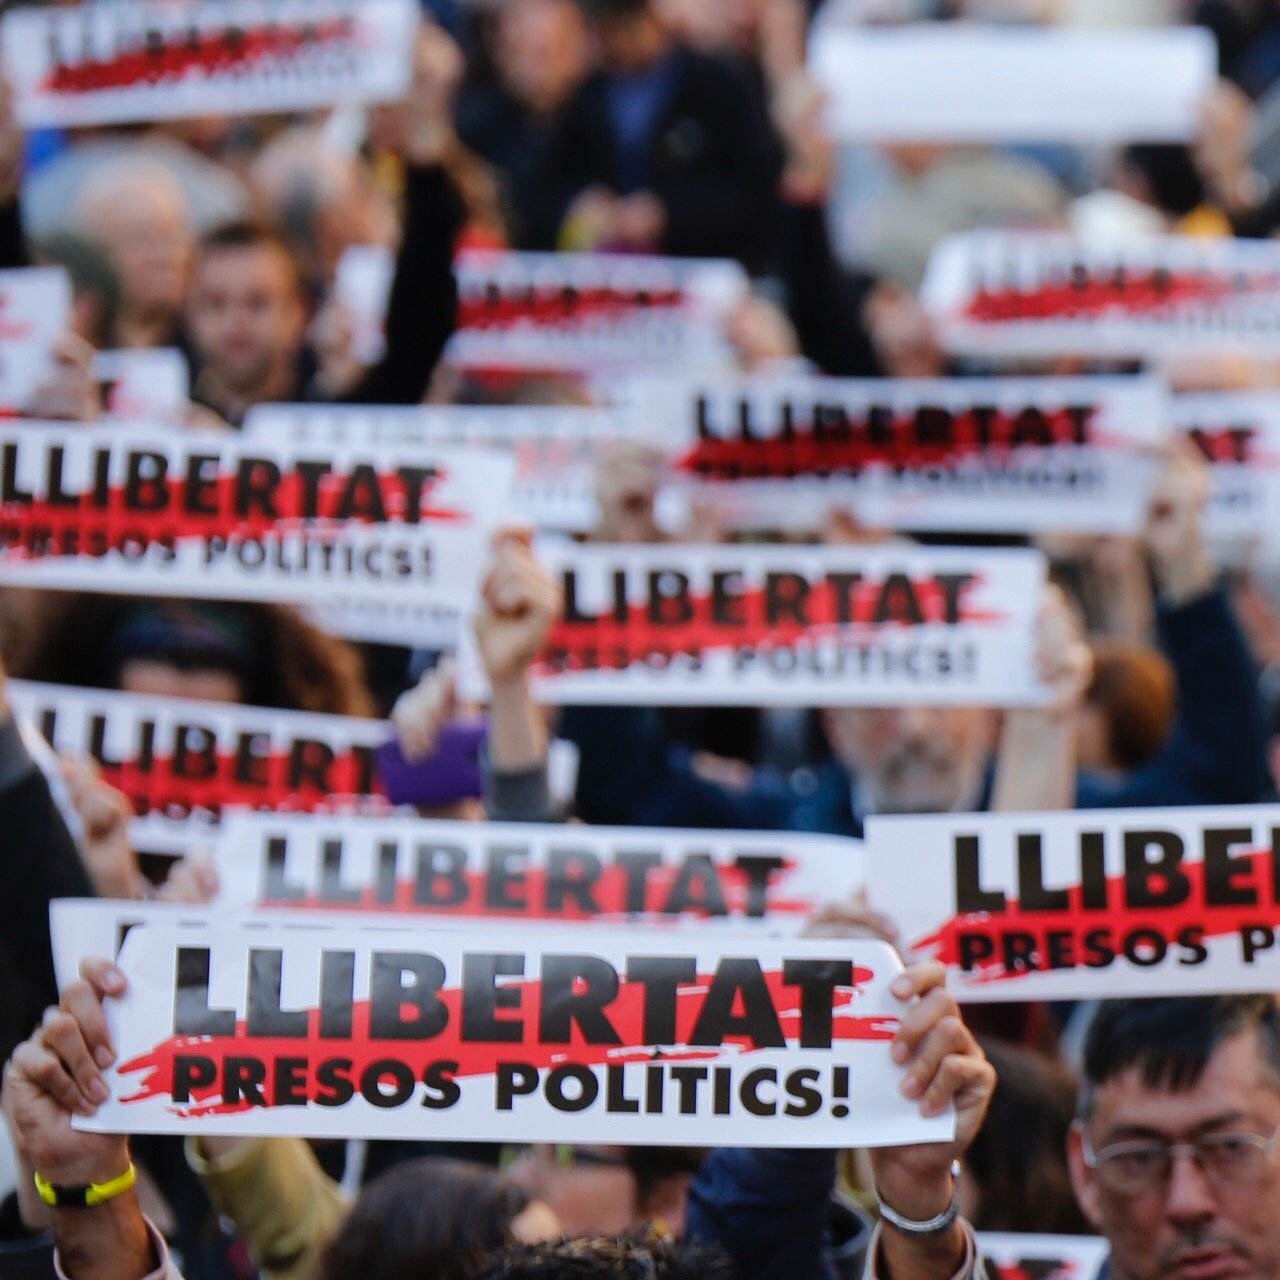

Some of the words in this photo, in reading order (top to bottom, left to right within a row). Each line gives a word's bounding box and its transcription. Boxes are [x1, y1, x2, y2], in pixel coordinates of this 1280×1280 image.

[698, 395, 1097, 447] LLIBERTAT
[2, 442, 440, 525] LLIBERTAT
[203, 531, 433, 580] POLÍTICS!
[562, 568, 977, 627] LIBERTAT
[42, 706, 376, 798] LLIBERT
[263, 833, 789, 918] LLIBERTAT
[956, 924, 1208, 973] PRESOS
[173, 944, 857, 1049] LLIBERTAT
[171, 1054, 463, 1110] PRESOS
[495, 1048, 852, 1120] POLÍTICS!
